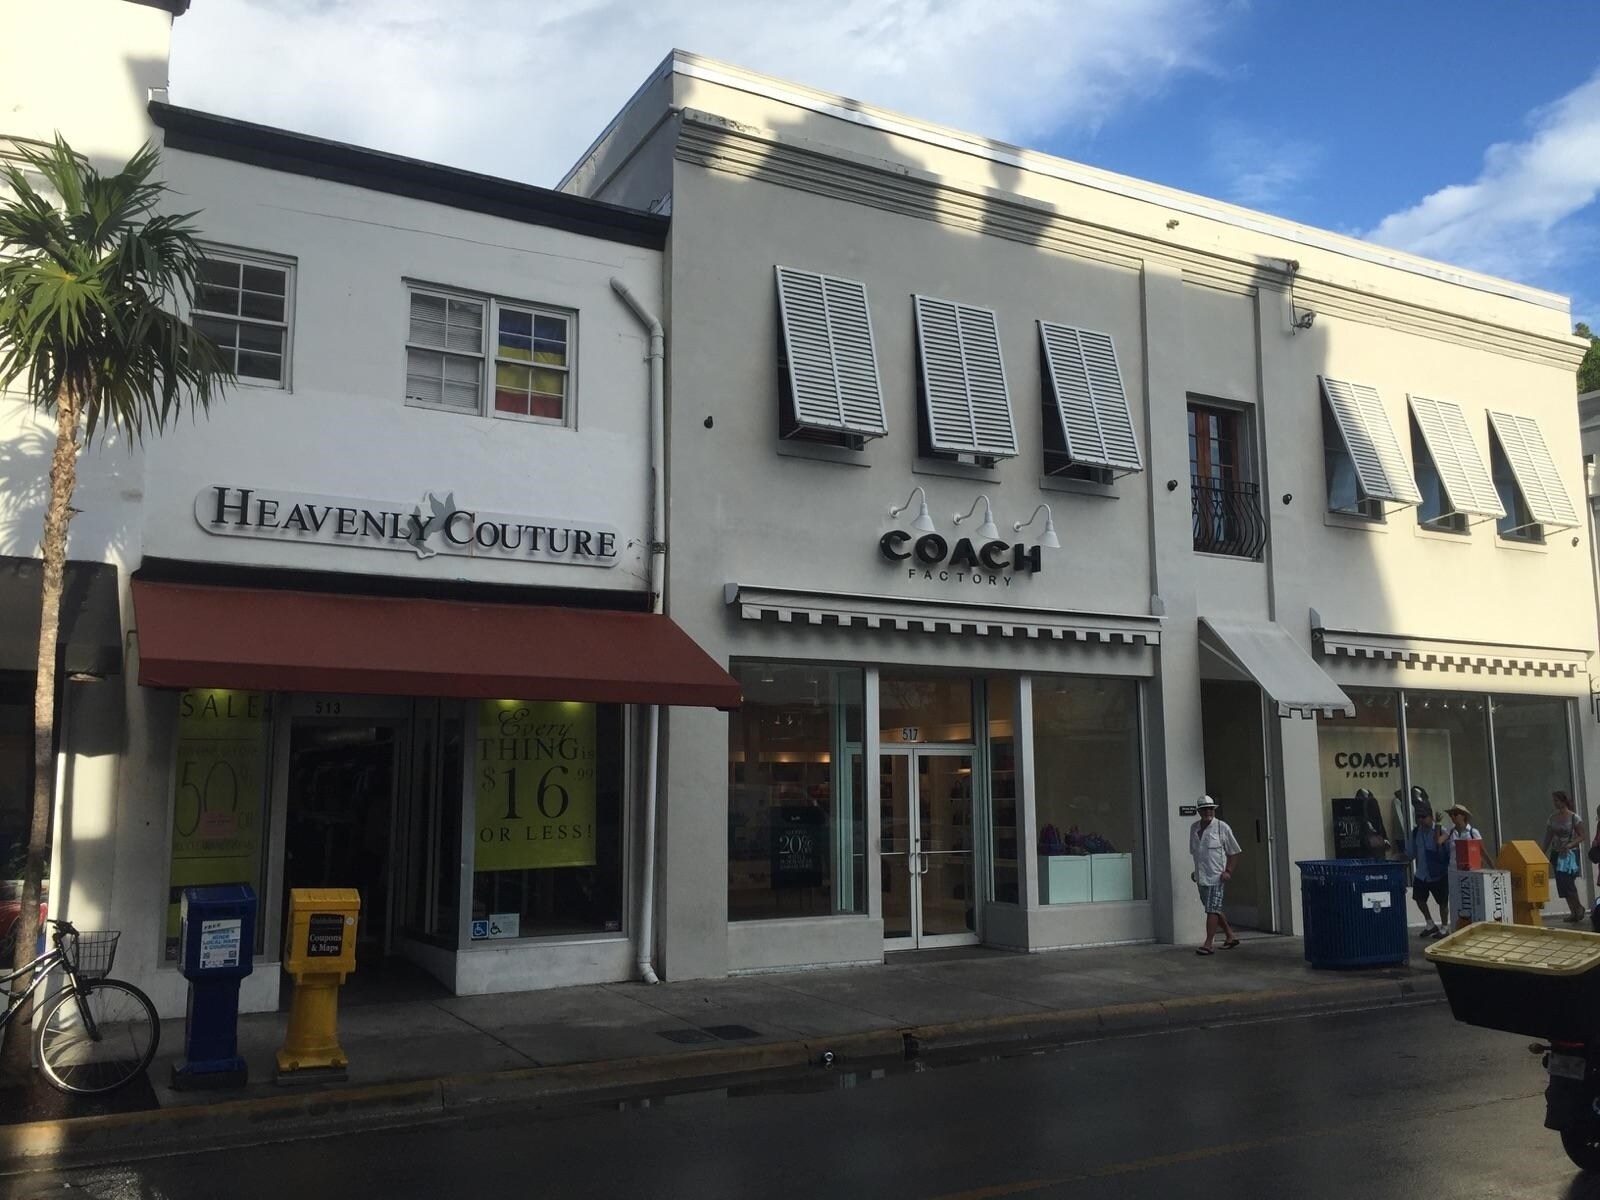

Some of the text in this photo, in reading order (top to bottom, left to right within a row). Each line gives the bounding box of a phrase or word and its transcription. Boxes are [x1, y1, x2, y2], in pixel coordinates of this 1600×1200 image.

[211, 486, 616, 558] HEAVENLY COUTURE
[880, 530, 1041, 574] COACH
[908, 569, 1012, 586] FACTORY
[181, 694, 259, 719] SALE
[316, 702, 340, 714] 513
[498, 708, 573, 737] Every
[902, 728, 918, 741] 517
[477, 737, 594, 761] THING is
[1335, 752, 1400, 769] COACH
[1345, 771, 1389, 779] FACTORY
[480, 824, 593, 843] OR LESS!
[310, 934, 342, 944] Coupons
[311, 944, 339, 953] & Maps
